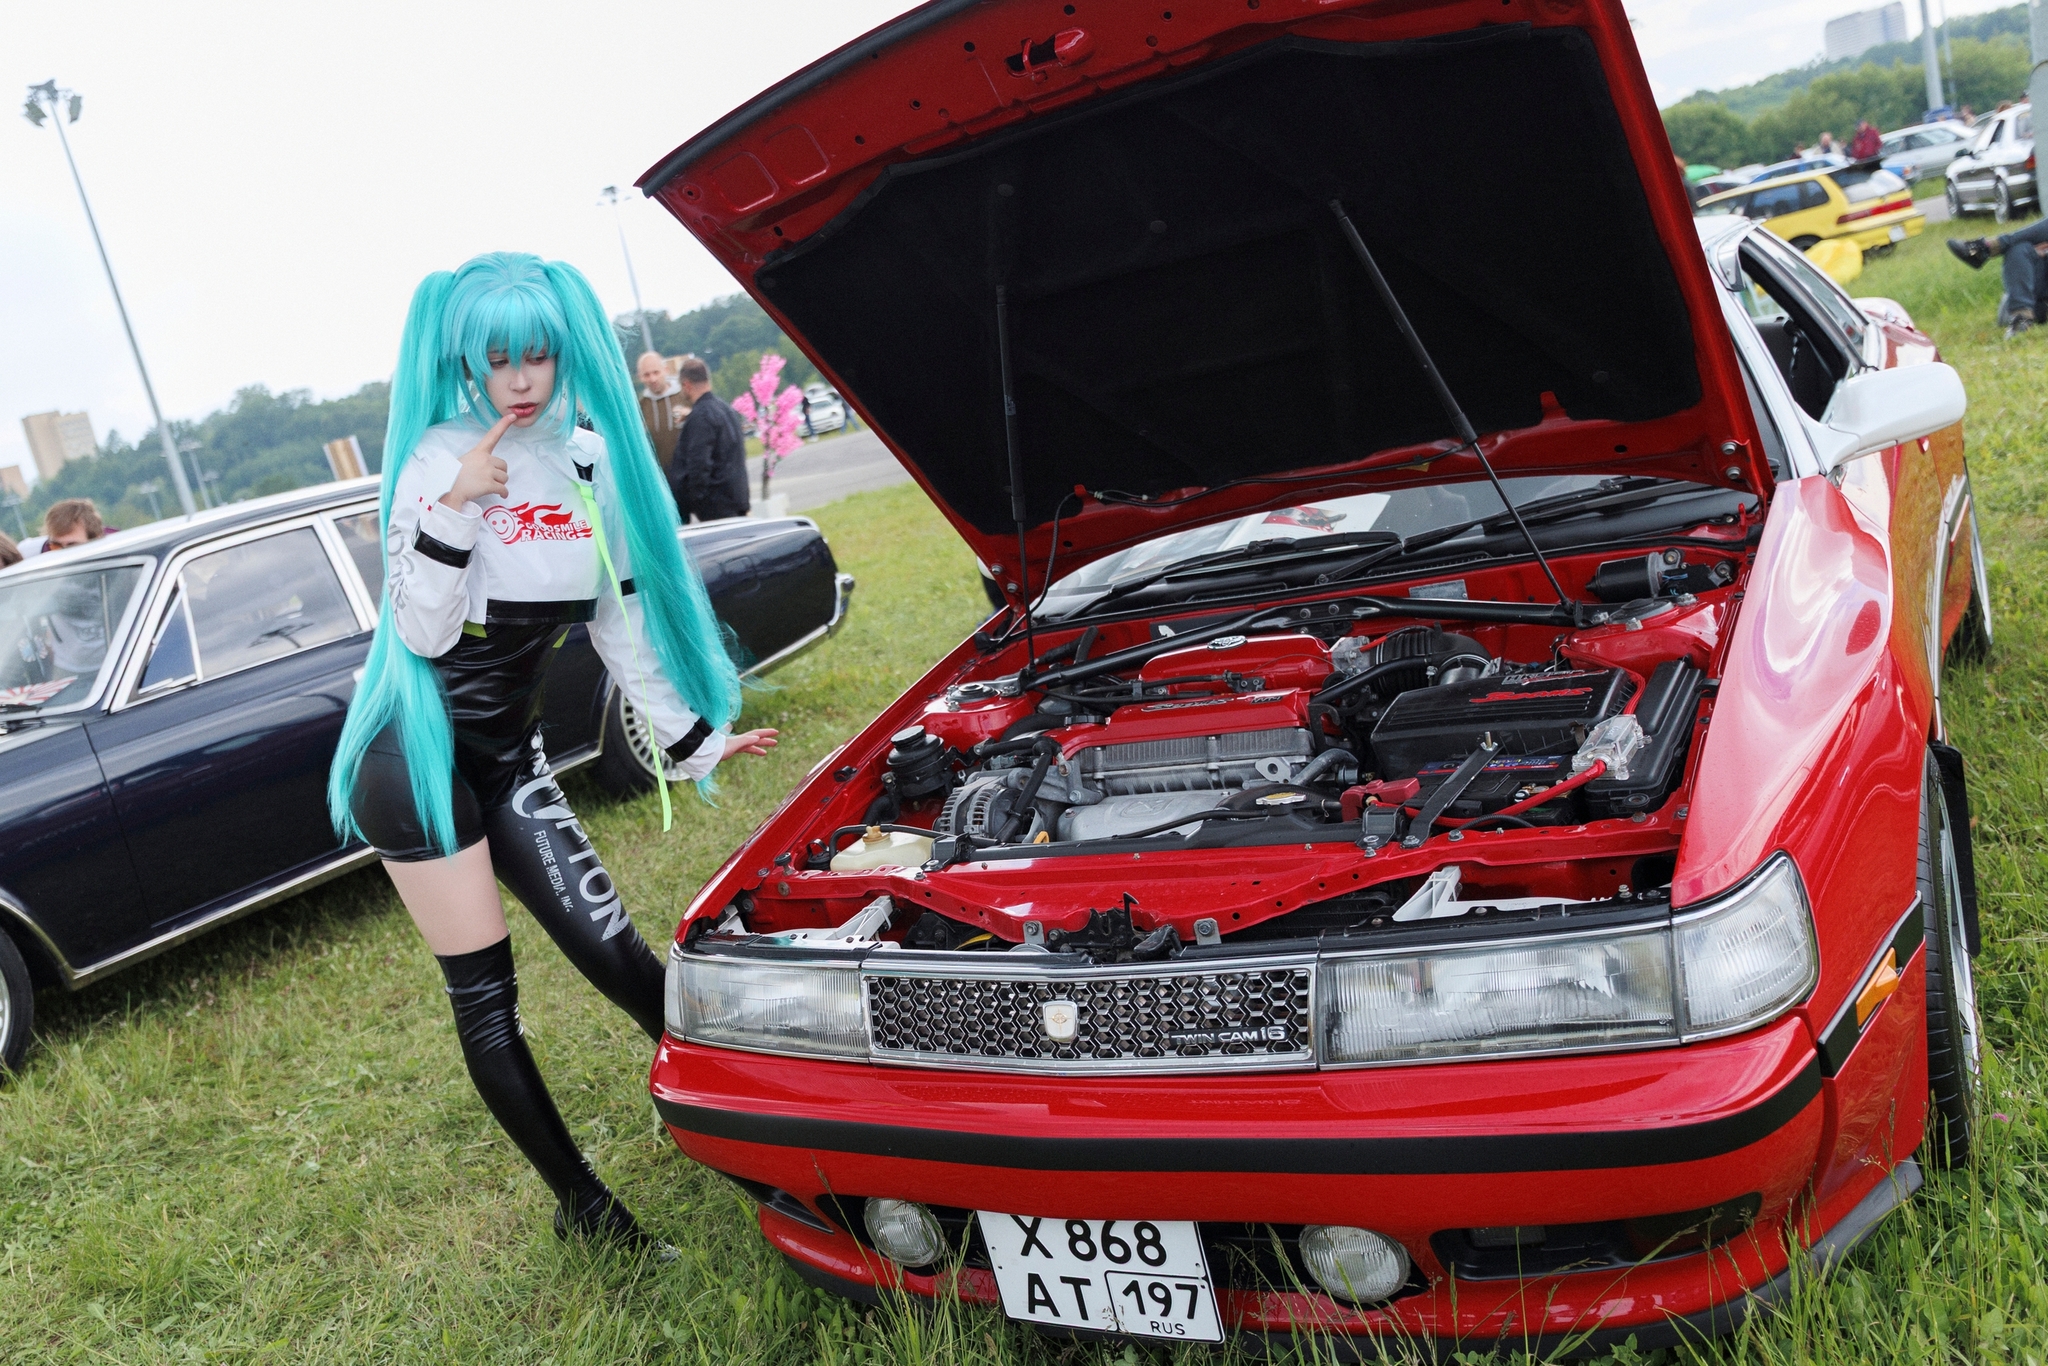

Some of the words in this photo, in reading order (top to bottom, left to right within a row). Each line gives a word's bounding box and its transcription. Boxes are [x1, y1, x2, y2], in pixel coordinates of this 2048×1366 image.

[521, 529, 577, 542] RACING
[533, 829, 557, 867] FUTURE
[1171, 1032, 1216, 1046] TWIN
[1218, 1030, 1259, 1044] CAM
[1260, 1026, 1286, 1041] 16
[1065, 1219, 1167, 1267] 868
[1027, 1272, 1092, 1321] AT
[1122, 1279, 1199, 1320] 197
[1150, 1320, 1186, 1336] RUS
